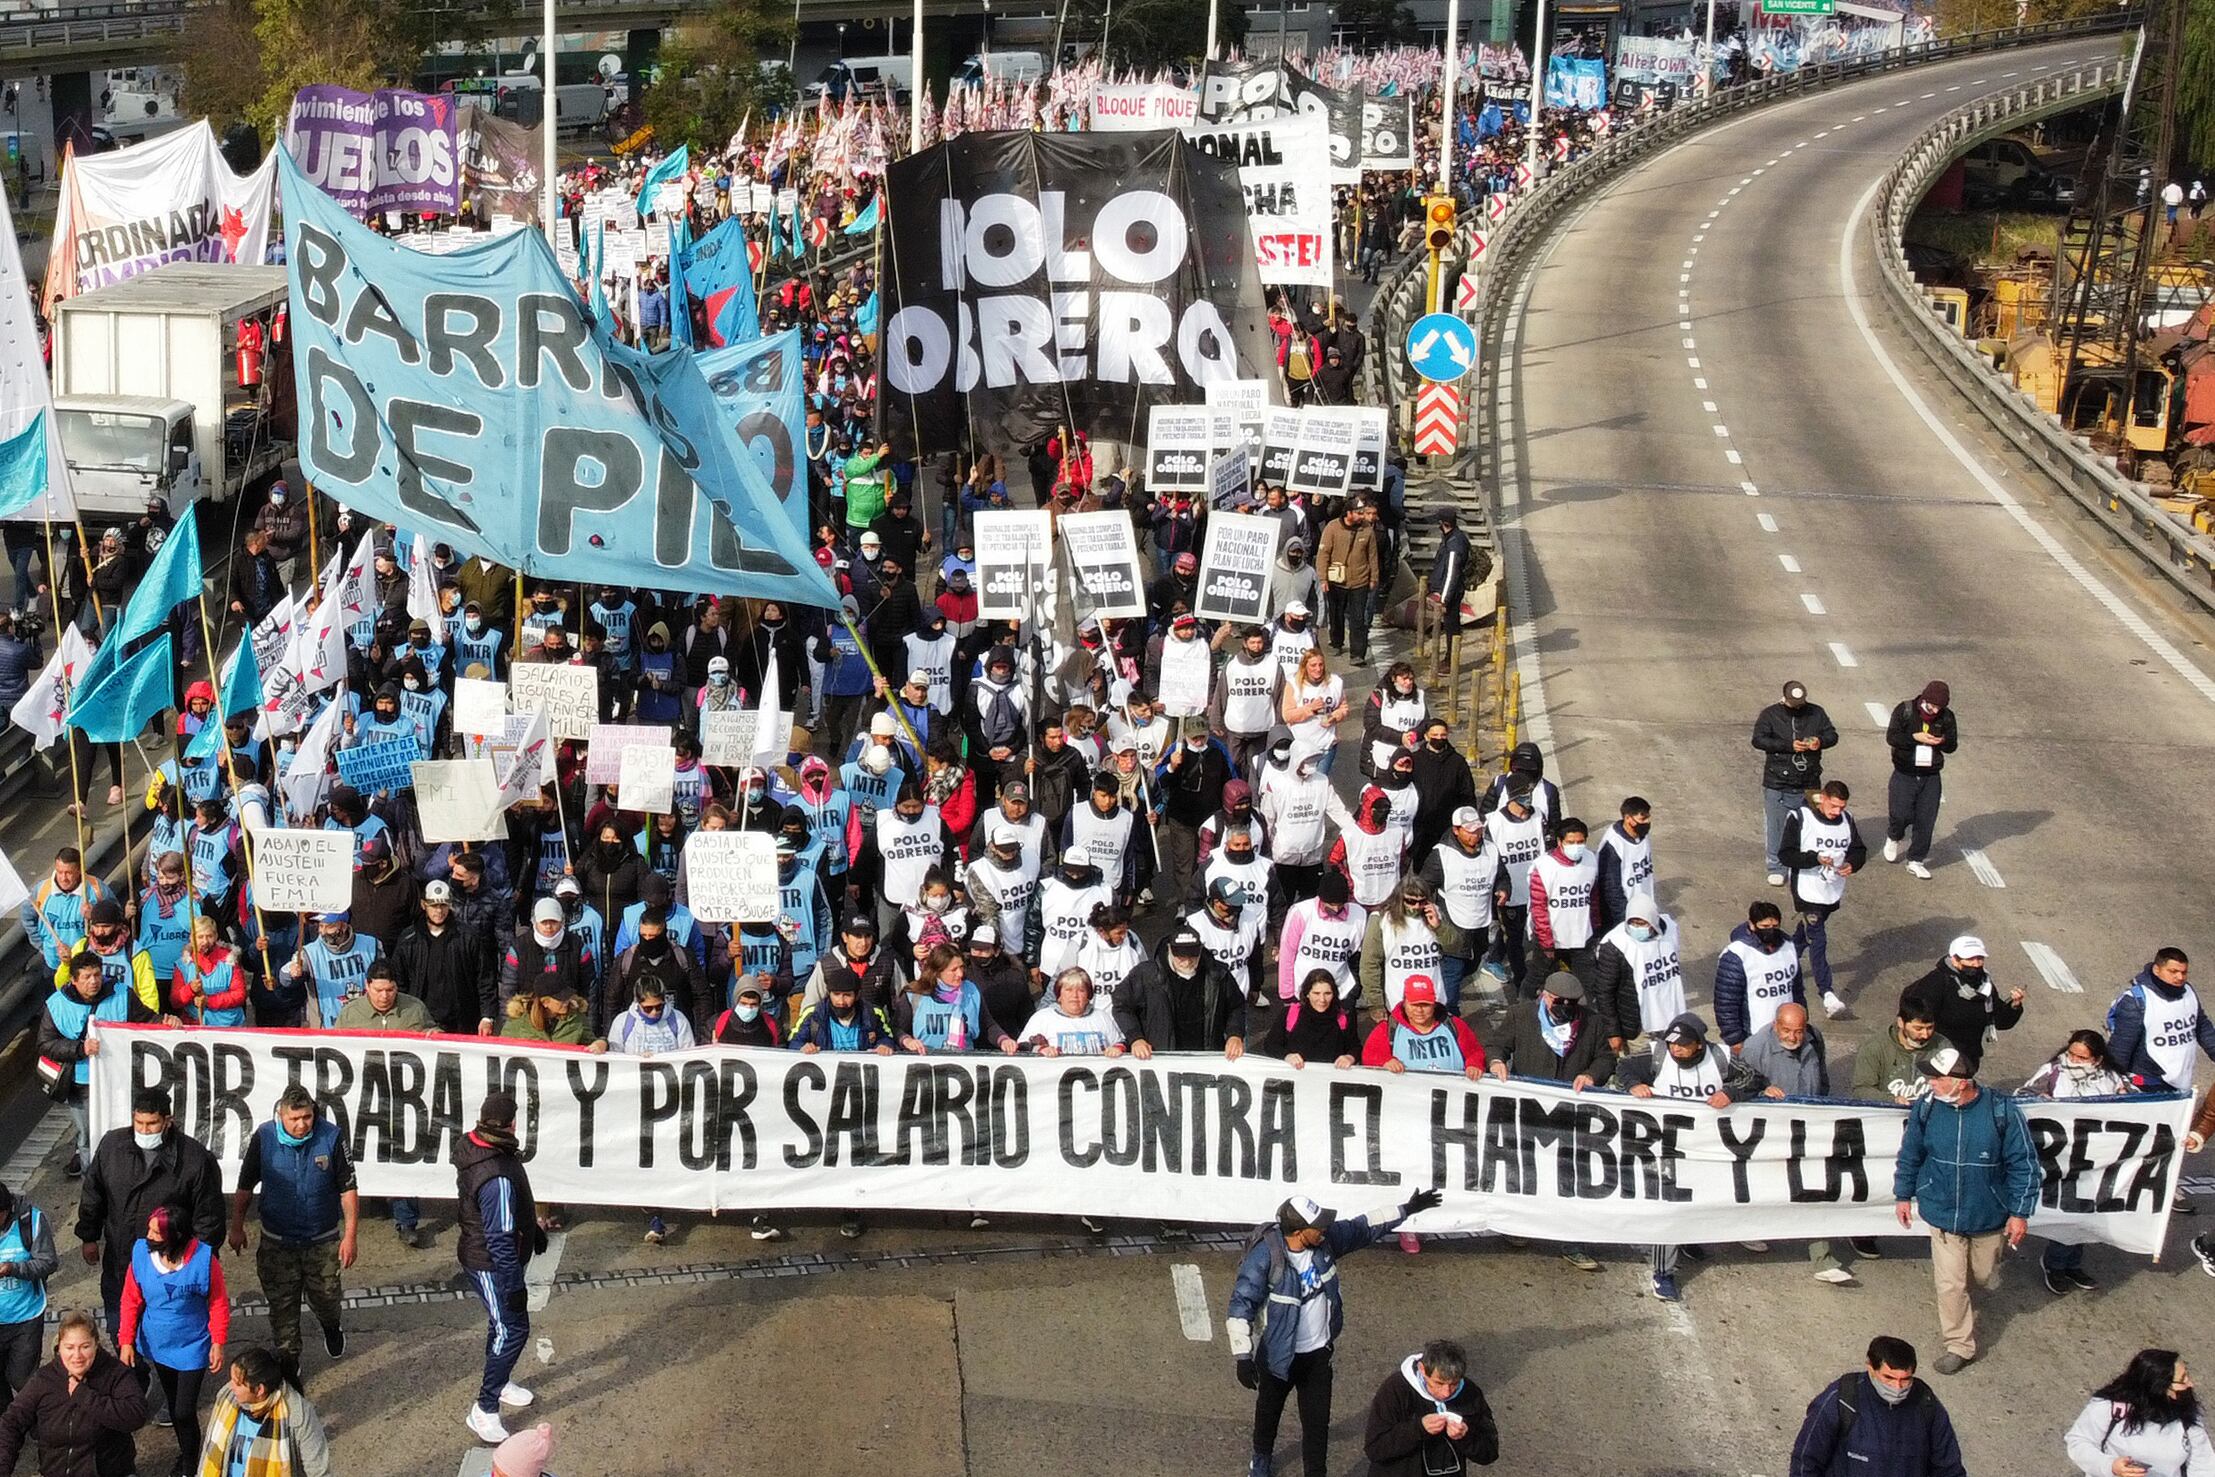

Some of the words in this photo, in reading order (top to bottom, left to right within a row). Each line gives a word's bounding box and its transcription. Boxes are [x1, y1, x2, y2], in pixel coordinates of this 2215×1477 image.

[394, 95, 425, 117] los
[1097, 96, 1146, 118] BLOQUE
[887, 291, 1238, 394] OBRERO
[1241, 388, 1261, 399] PARO
[308, 346, 483, 535] DE
[1164, 455, 1197, 465] POLO
[1308, 457, 1339, 468] POLO
[1156, 464, 1205, 474] OBRERO
[1298, 464, 1345, 478] OBRERO
[1217, 527, 1233, 540] POR
[1246, 530, 1269, 544] PARO
[1215, 540, 1260, 556] NACIONAL
[1212, 553, 1232, 567] PLAN
[1241, 557, 1265, 570] LUCHA
[1085, 571, 1122, 583] POLO
[1216, 575, 1252, 589] POLO
[1206, 584, 1259, 601] OBRERO
[600, 613, 627, 628] MTR
[463, 645, 491, 660] MTR
[1278, 644, 1307, 655] POLO
[517, 665, 594, 689] SALARIOS
[1235, 676, 1267, 688] POLO
[516, 683, 575, 704] IGUALES
[580, 691, 591, 705] A
[1230, 686, 1273, 697] OBRERO
[402, 692, 432, 713] MTR
[516, 697, 534, 711] LA
[338, 738, 416, 763] ALIMENTOS
[626, 747, 673, 767] BASTA
[853, 780, 887, 797] MTR
[1286, 809, 1320, 820] OBRERO
[1293, 803, 1314, 812] POLO
[805, 809, 840, 829] MTR
[263, 838, 311, 854] ABAJO
[316, 840, 337, 852] EL
[694, 835, 731, 849] BASTA
[735, 836, 751, 849] DE
[894, 832, 932, 848] POLO
[1092, 839, 1115, 849] POLO
[1506, 837, 1540, 854] POLO
[1816, 836, 1849, 849] POLO
[887, 845, 941, 861] OBRERO
[1086, 846, 1121, 856] OBRERO
[745, 854, 772, 867] QUE
[1362, 861, 1395, 873] OBRERO
[1367, 855, 1390, 864] POLO
[265, 871, 320, 887] FUERA
[690, 866, 752, 880] PRODUCEN
[1465, 876, 1487, 886] POLO
[1001, 882, 1035, 900] POLO
[1460, 882, 1493, 893] OBRERO
[1560, 883, 1592, 897] POLO
[1312, 934, 1351, 949] POLO
[1401, 941, 1439, 957] POLO
[744, 944, 781, 968] MTR
[1210, 944, 1246, 960] POLO
[1300, 945, 1353, 963] OBRERO
[328, 955, 364, 980] MTR
[1644, 951, 1679, 976] POLO
[1764, 962, 1799, 985] POLO
[2162, 1013, 2198, 1034] POLO
[1669, 1082, 1717, 1098] POLO
[130, 1040, 256, 1162] POR
[566, 1061, 609, 1168] Y
[639, 1060, 760, 1172] POR
[782, 1061, 1029, 1169] SALARIO
[1058, 1067, 1298, 1183] CONTRA
[1329, 1081, 1401, 1185] EL
[1430, 1088, 1696, 1202] HAMBRE
[1717, 1116, 1767, 1203] Y
[1788, 1118, 1869, 1203] LA
[2028, 1118, 2180, 1214] REZA
